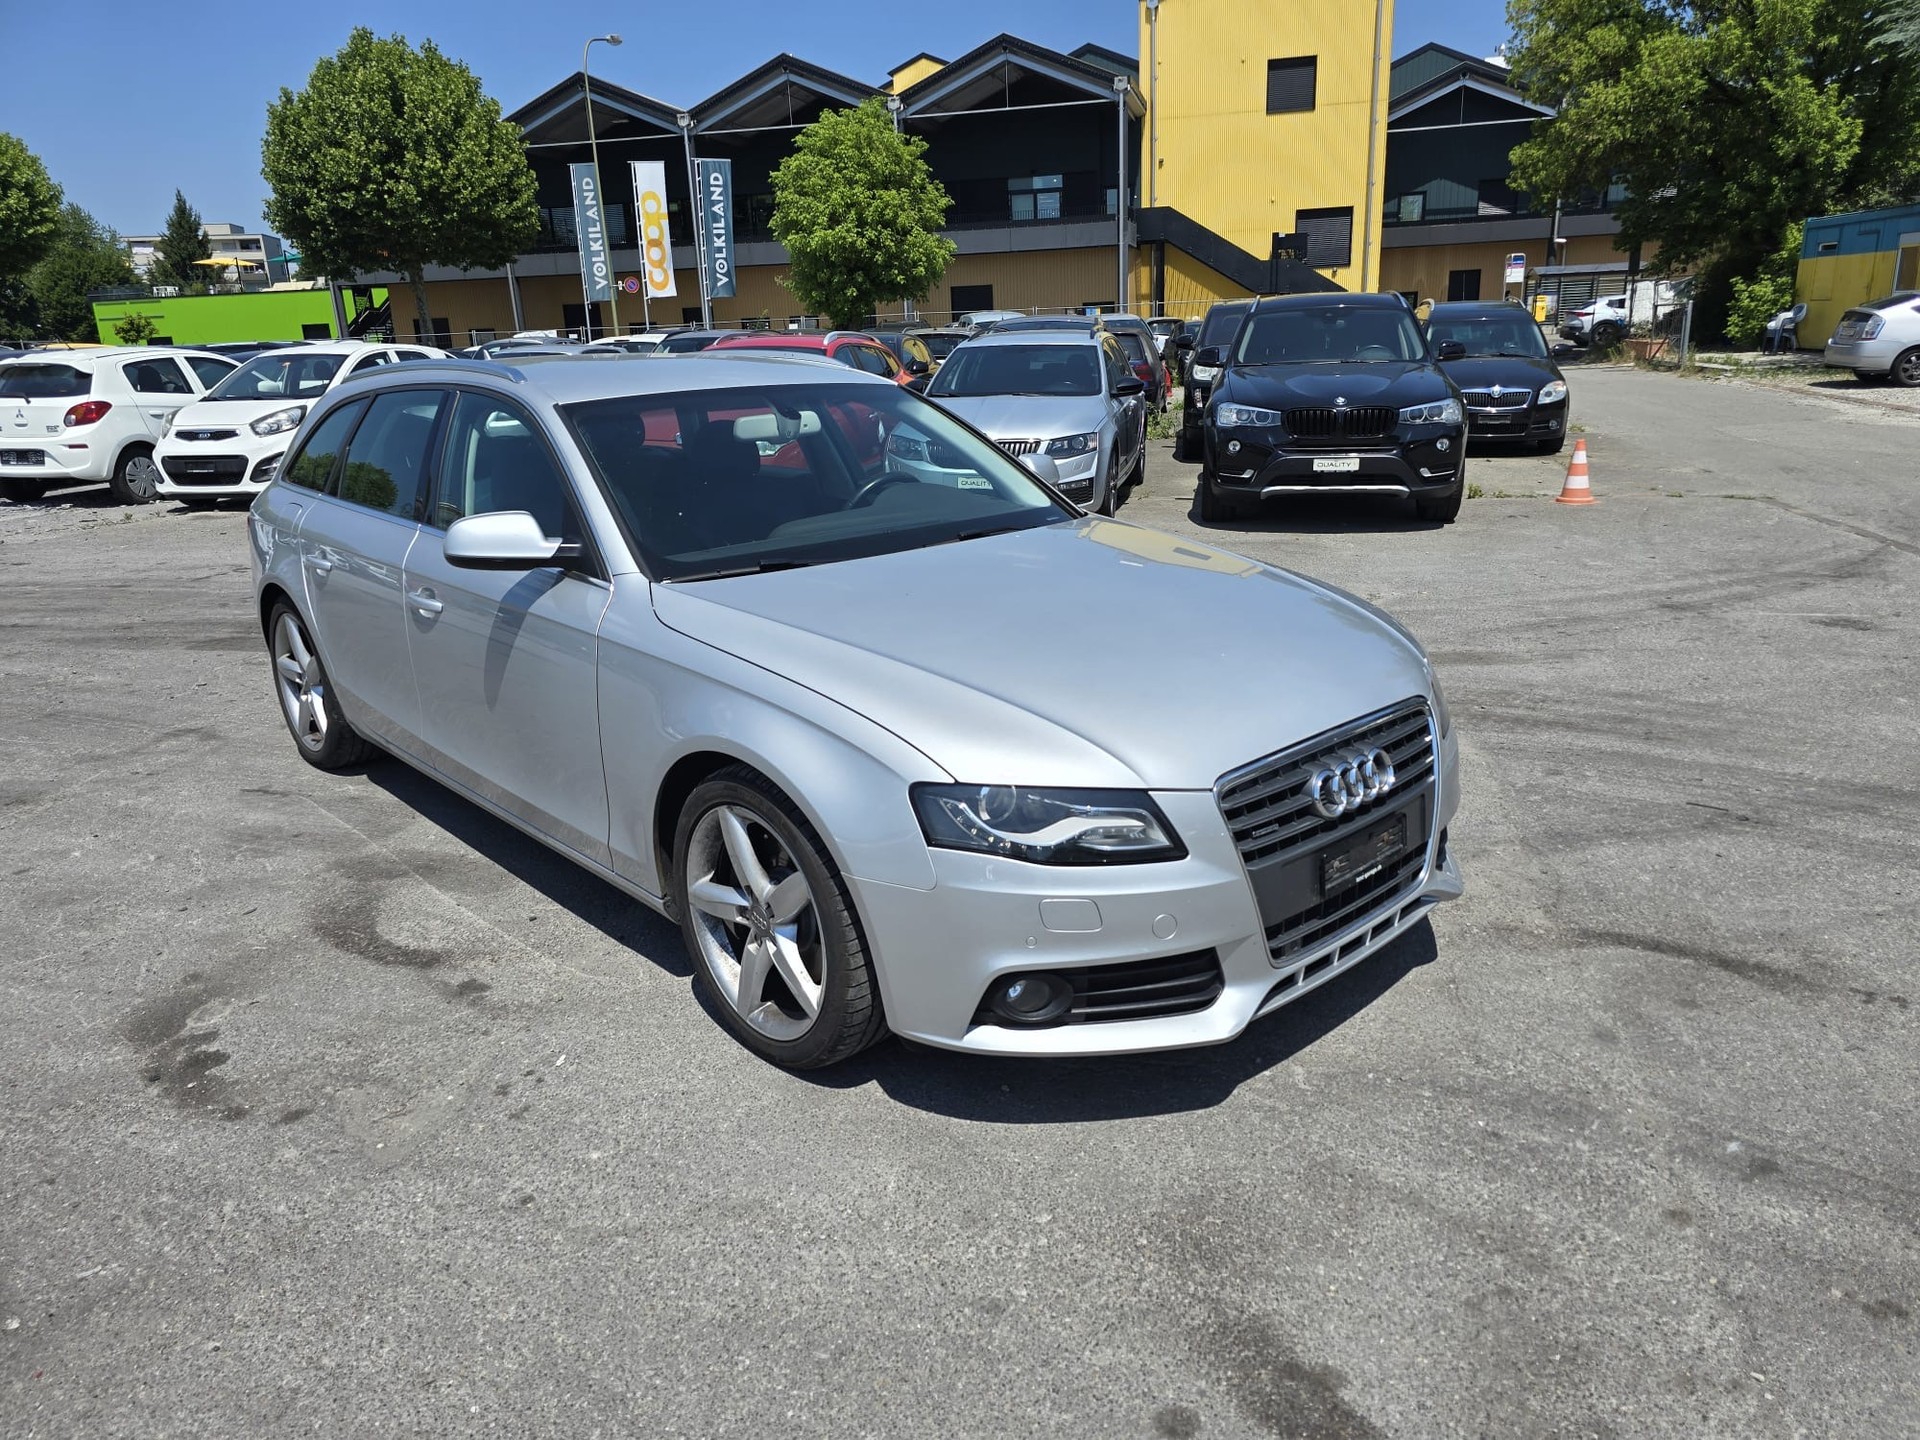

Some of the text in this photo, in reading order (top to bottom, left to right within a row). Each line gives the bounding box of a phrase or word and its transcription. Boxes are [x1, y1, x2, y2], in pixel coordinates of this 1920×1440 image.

[582, 177, 609, 290] VOLKILAND
[640, 190, 670, 291] coop
[709, 172, 729, 287] VOLKILAND
